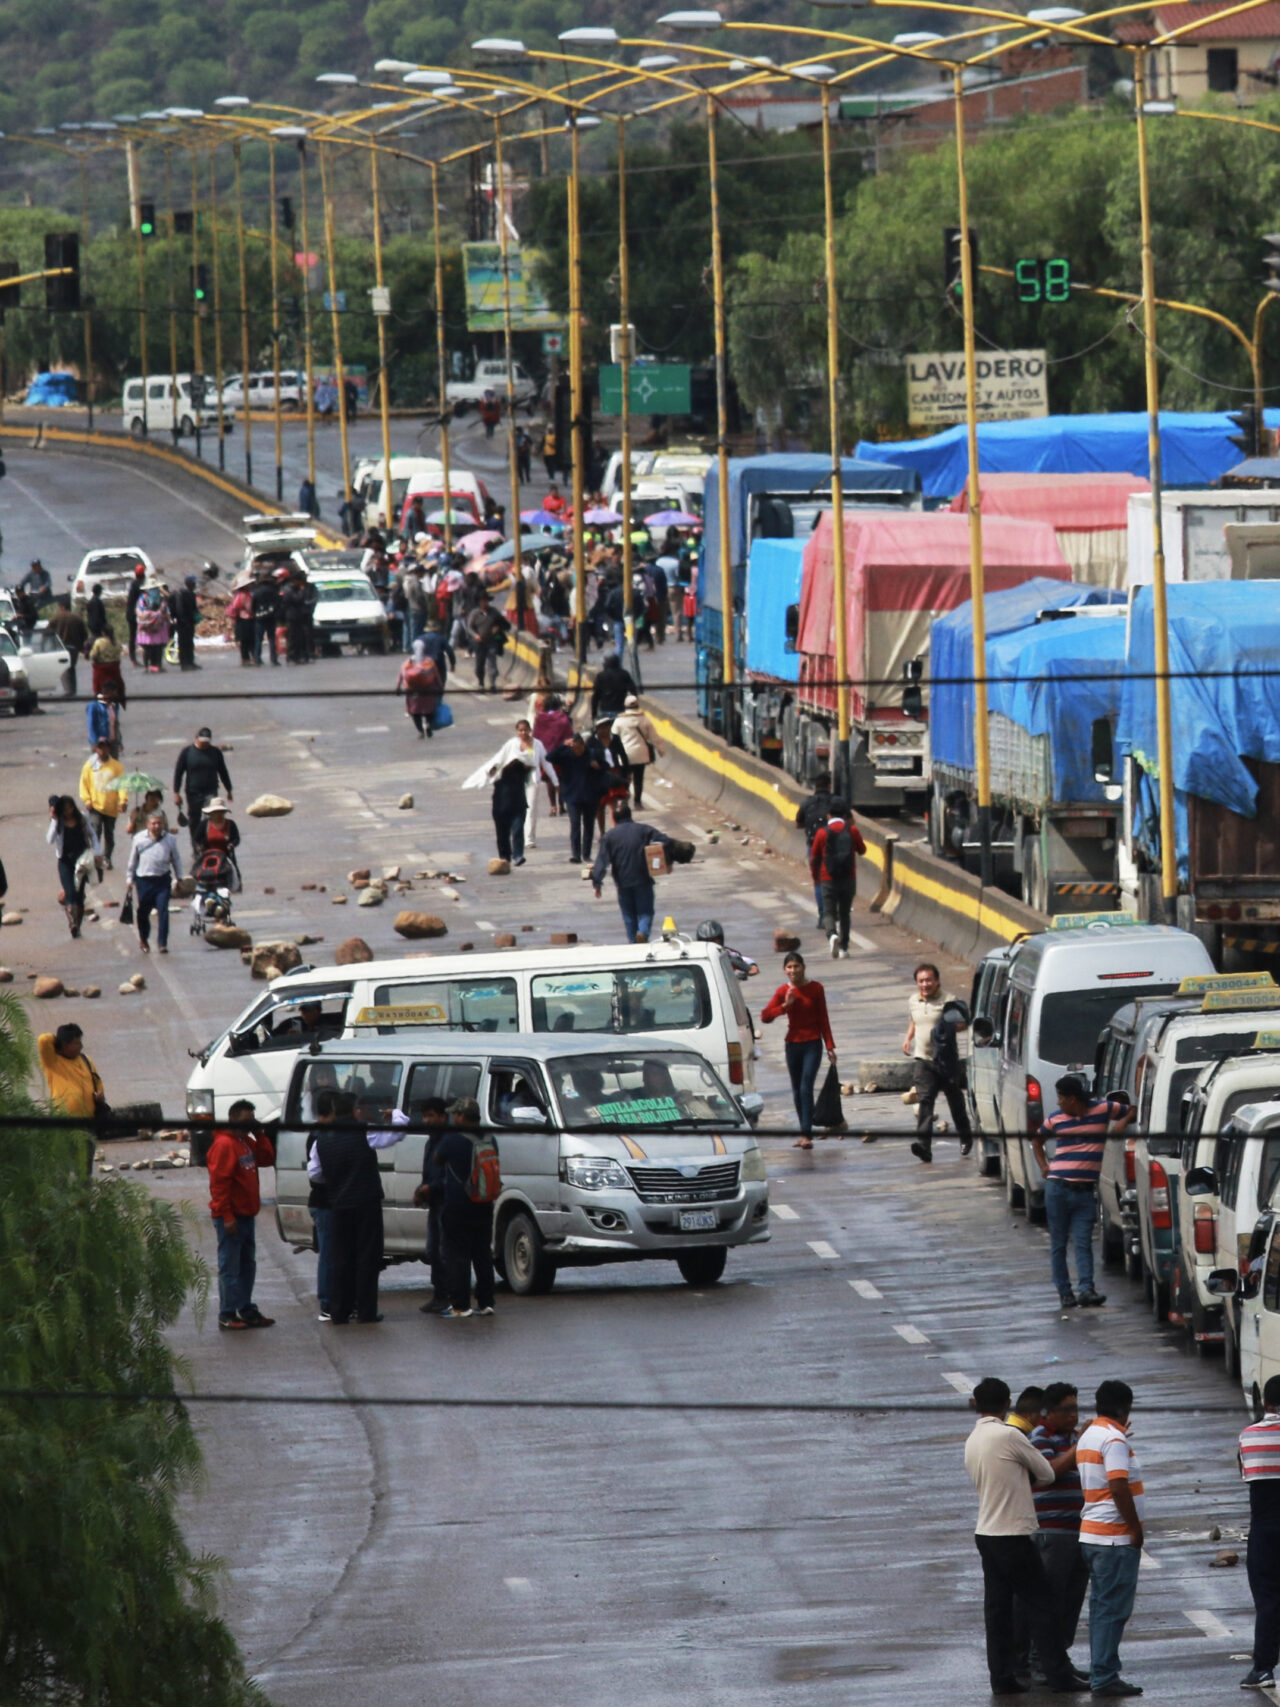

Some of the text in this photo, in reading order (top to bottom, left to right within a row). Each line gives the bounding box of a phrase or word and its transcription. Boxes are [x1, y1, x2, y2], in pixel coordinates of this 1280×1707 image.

[1016, 259, 1070, 302] 58
[911, 388, 1041, 404] CAMIONS Y AUTOS
[1207, 979, 1258, 990] 4380044
[597, 1097, 676, 1115] QUILLACOLLO
[639, 1109, 682, 1124] BOLIVAR
